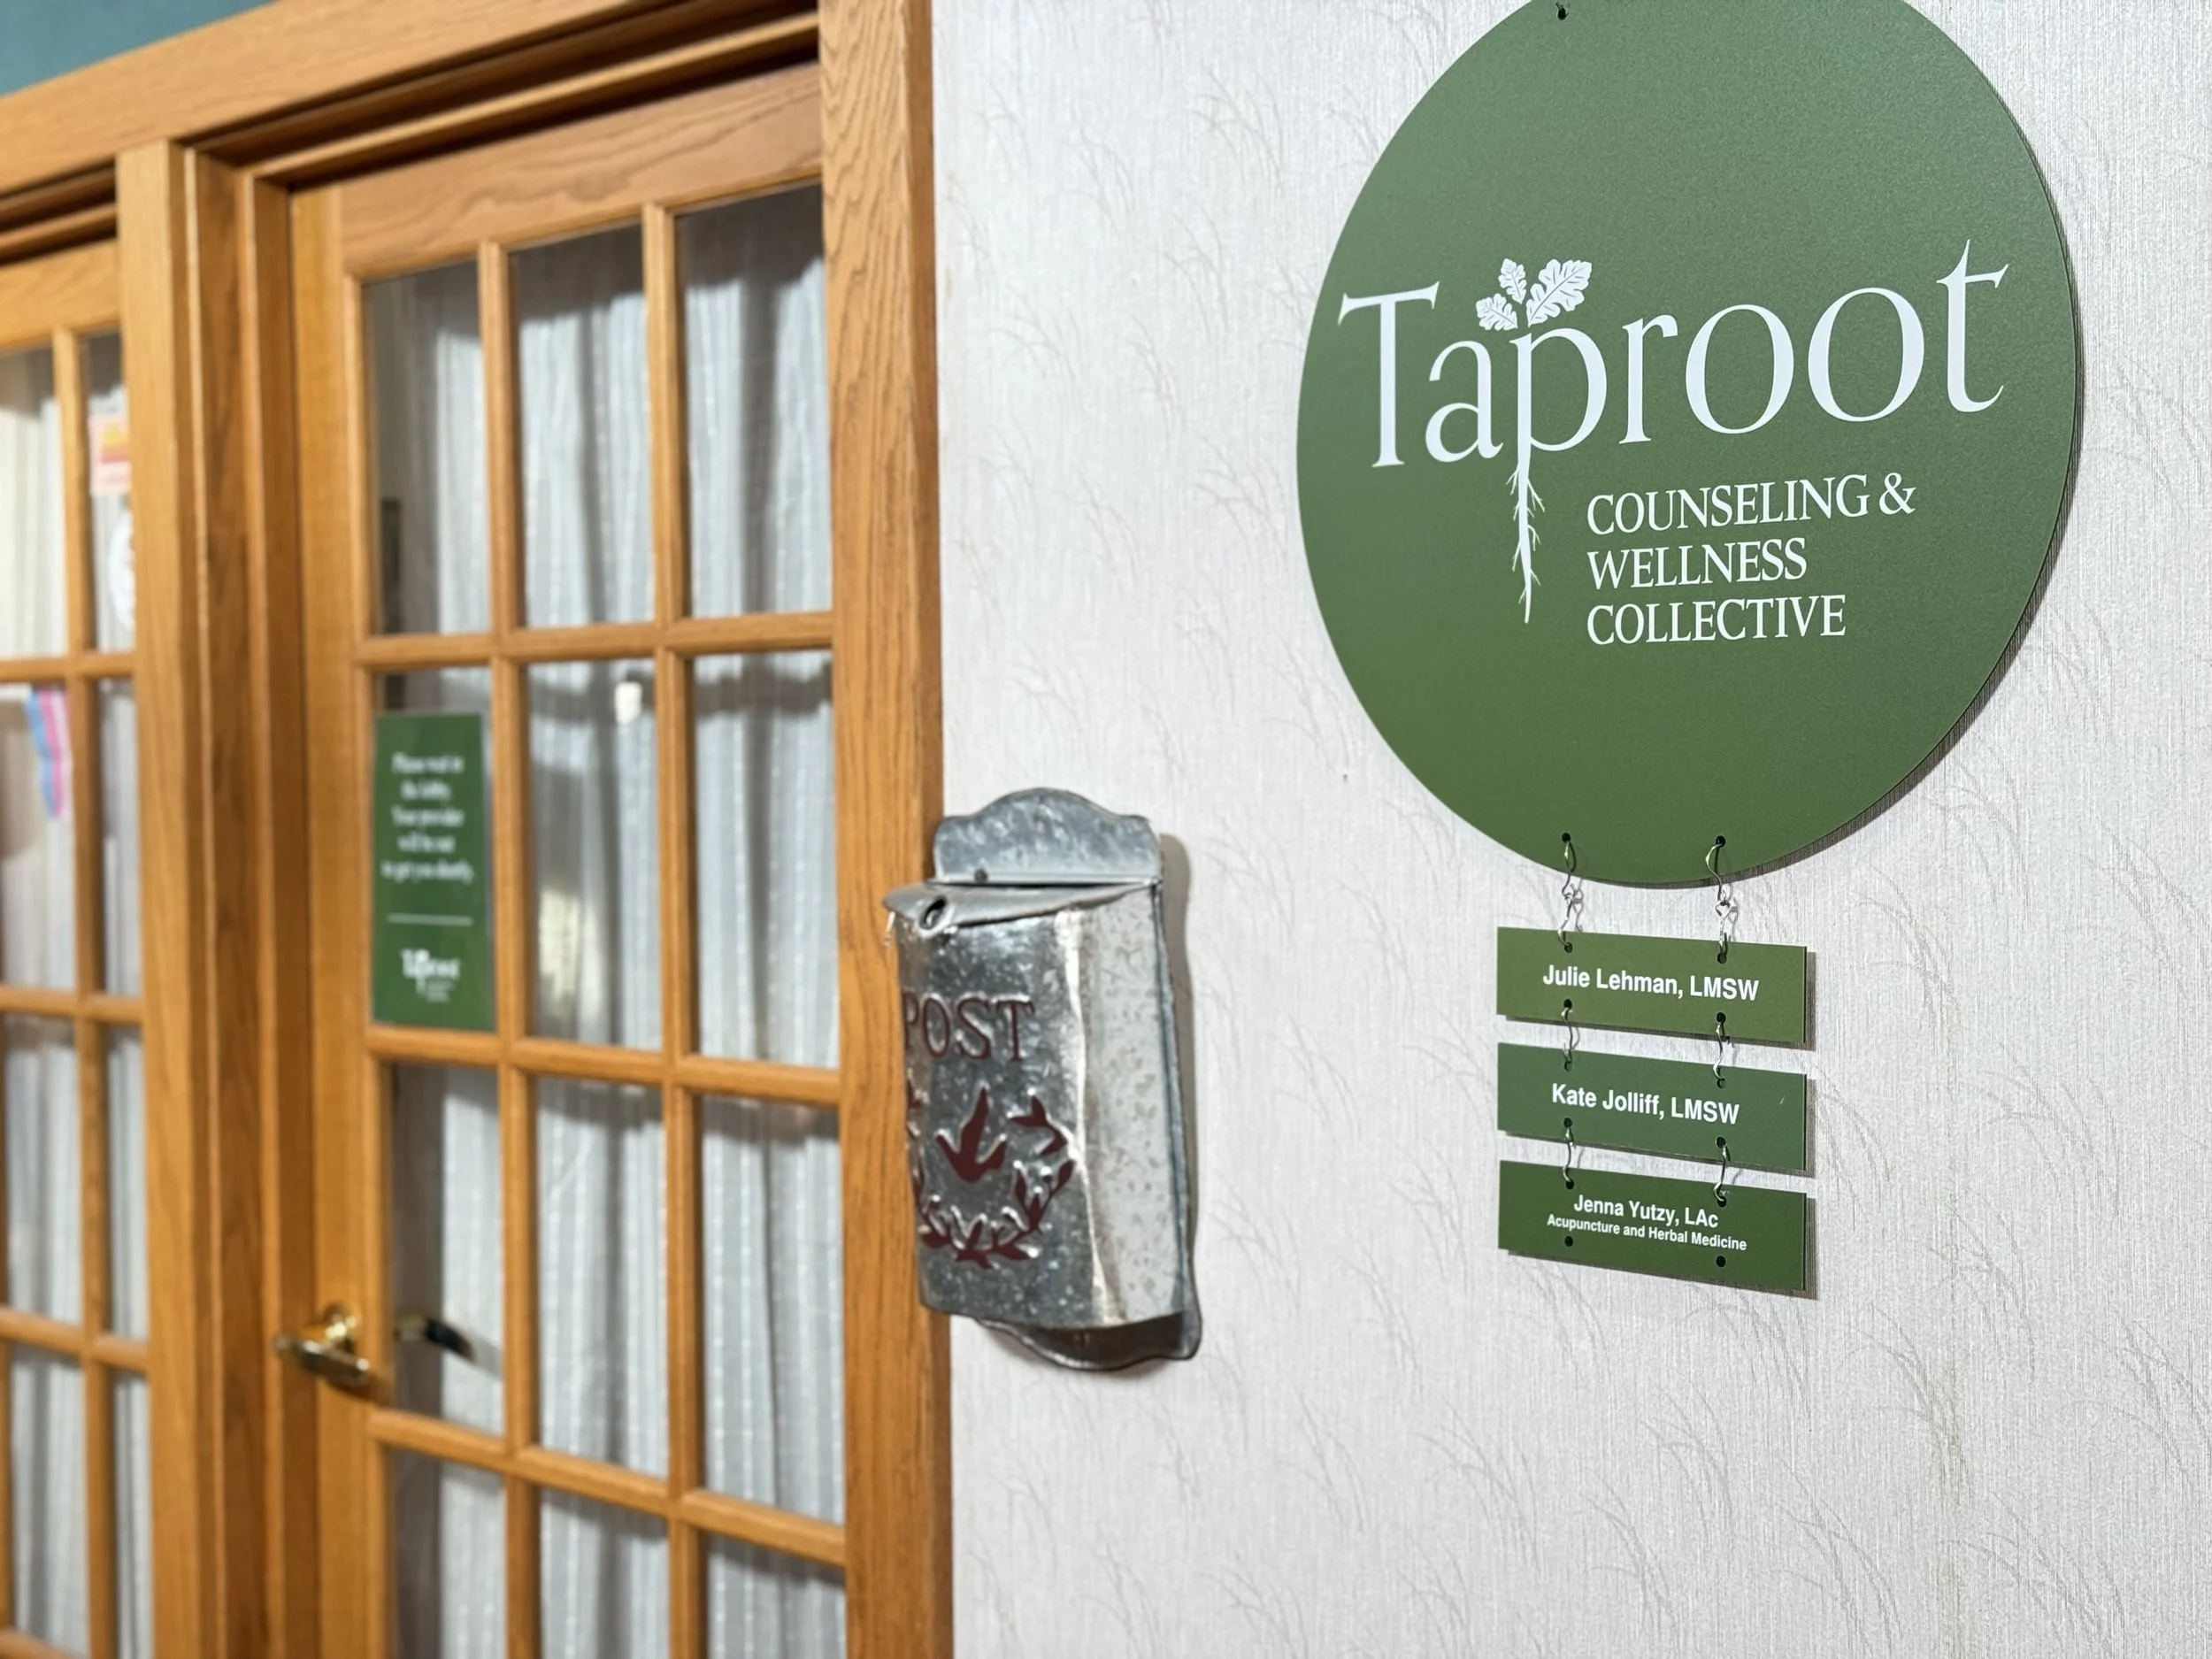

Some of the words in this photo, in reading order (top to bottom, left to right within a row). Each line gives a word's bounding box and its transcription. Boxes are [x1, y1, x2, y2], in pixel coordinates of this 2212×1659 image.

[1337, 238, 2010, 623] Taproot
[1586, 473, 1870, 535] COUNSELING
[1878, 472, 1916, 515] &
[1586, 537, 1808, 590] WELLNESS
[1586, 594, 1847, 646] COLLECTIVE
[1542, 964, 1591, 988] Julie
[1596, 968, 1684, 1000] Lehman,
[1690, 975, 1760, 1002] LMSW
[902, 988, 1035, 1062] POST
[1552, 1082, 1597, 1108] Kate
[1601, 1089, 1664, 1120] Jolliff,
[1671, 1096, 1740, 1125] LMSW
[1547, 1213, 1621, 1235] Acupuncture
[1623, 1225, 1646, 1238] and
[1648, 1226, 1688, 1243] Herbal
[1691, 1231, 1747, 1251] Medicine
[1573, 1194, 1624, 1217] Jenna
[1628, 1200, 1679, 1227] Yutzy,
[1685, 1207, 1719, 1228] LAc
